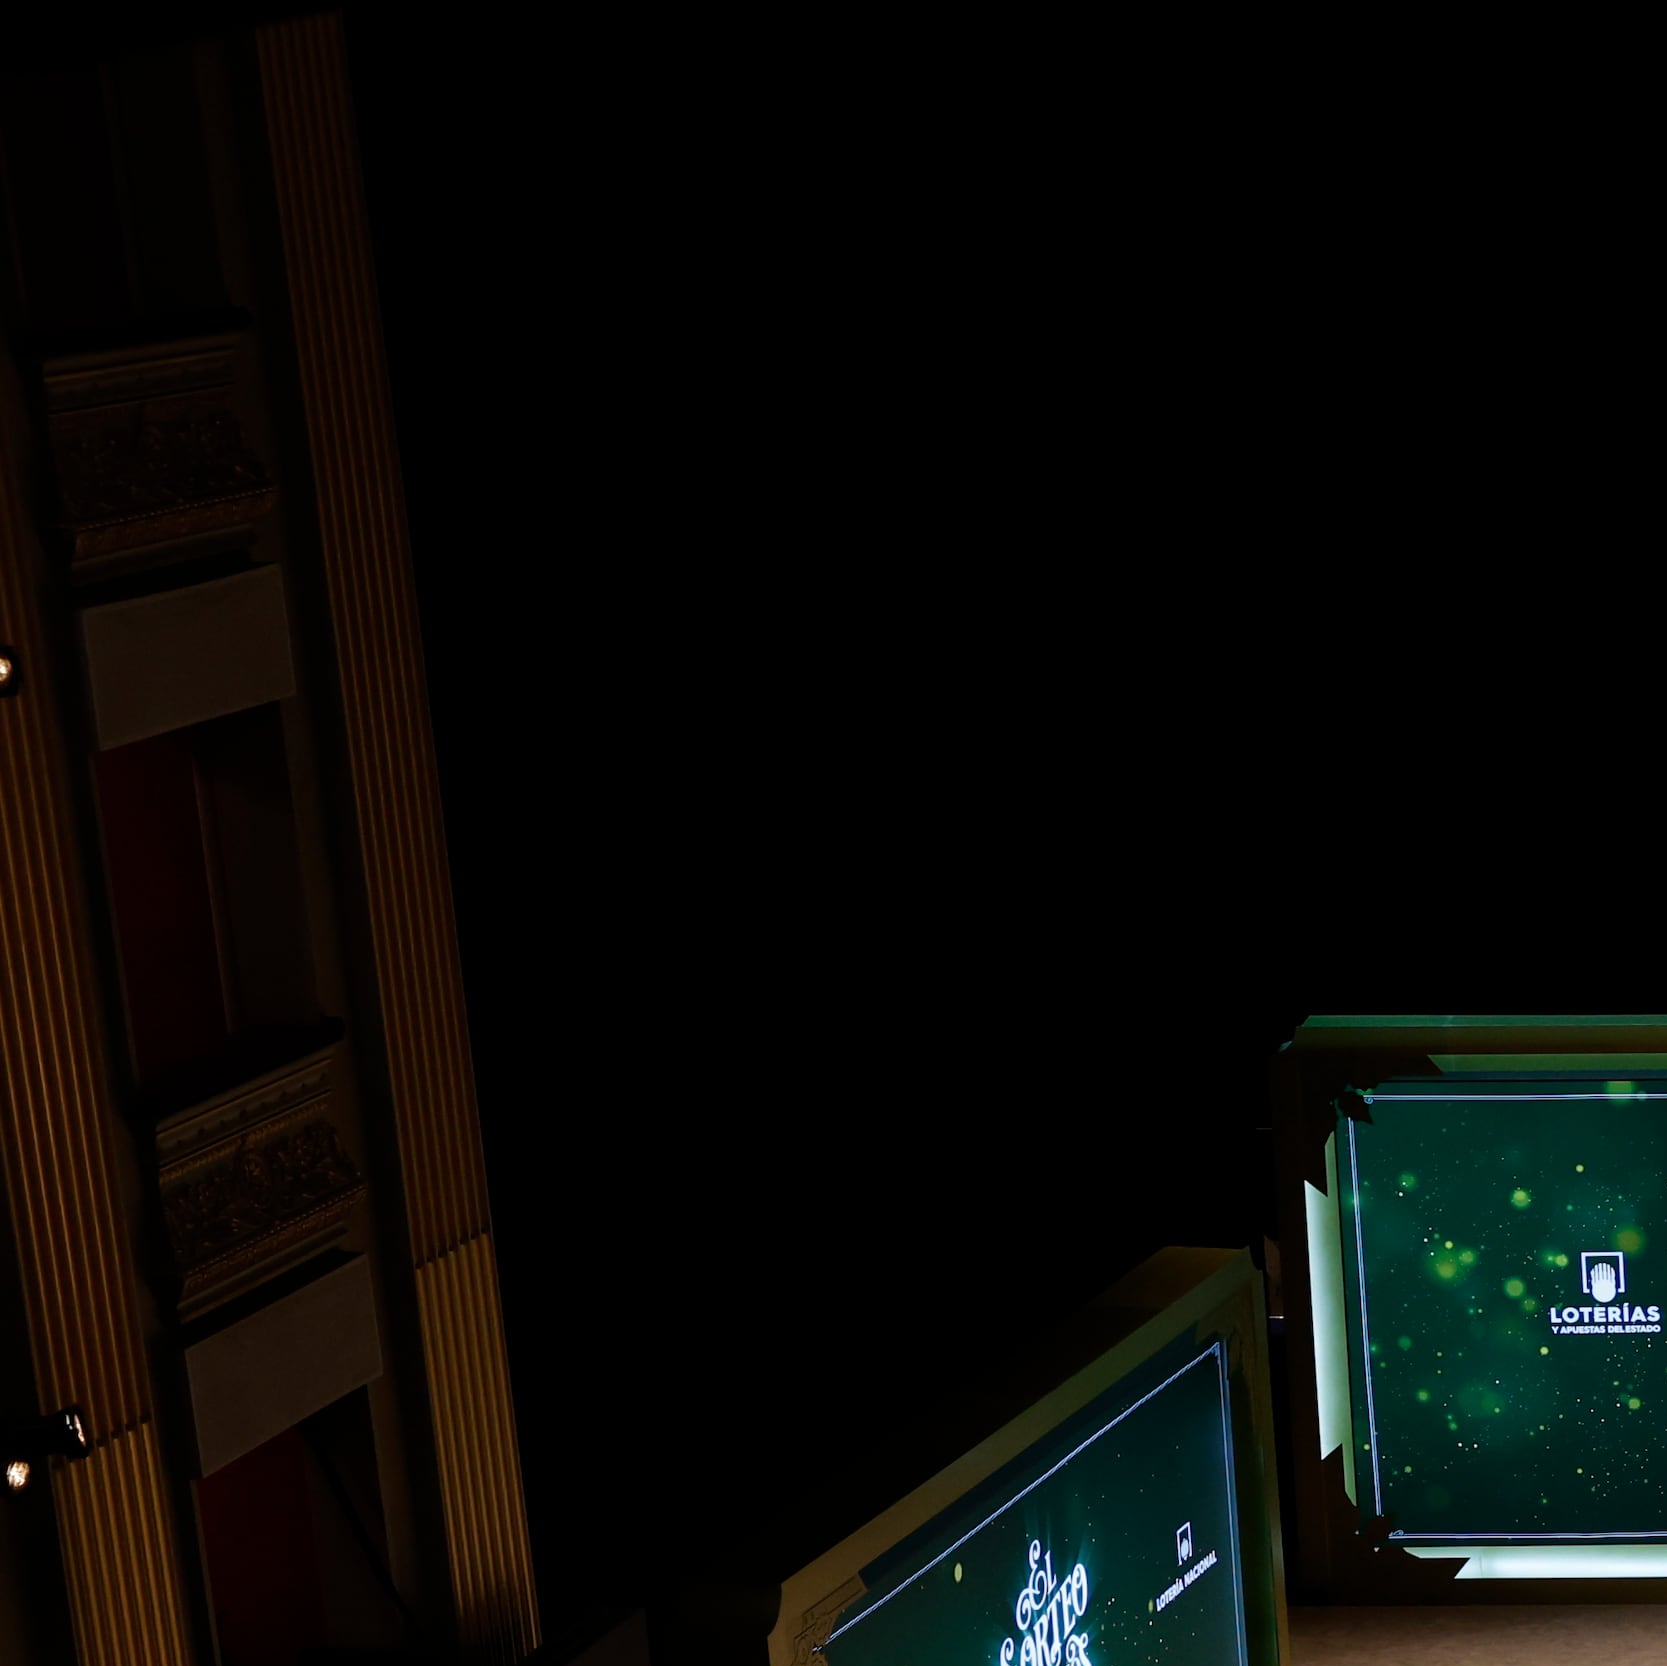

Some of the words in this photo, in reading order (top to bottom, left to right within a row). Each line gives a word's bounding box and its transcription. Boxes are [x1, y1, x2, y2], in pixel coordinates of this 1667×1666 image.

[1550, 1302, 1661, 1323] LOTERÍAS
[1551, 1326, 1559, 1335] Y
[1560, 1325, 1606, 1334] APUESTAS
[1607, 1325, 1624, 1333] DEL
[1625, 1324, 1661, 1333] ESTADO
[1184, 1549, 1217, 1587] NACIONAL
[1016, 1539, 1057, 1630] EL
